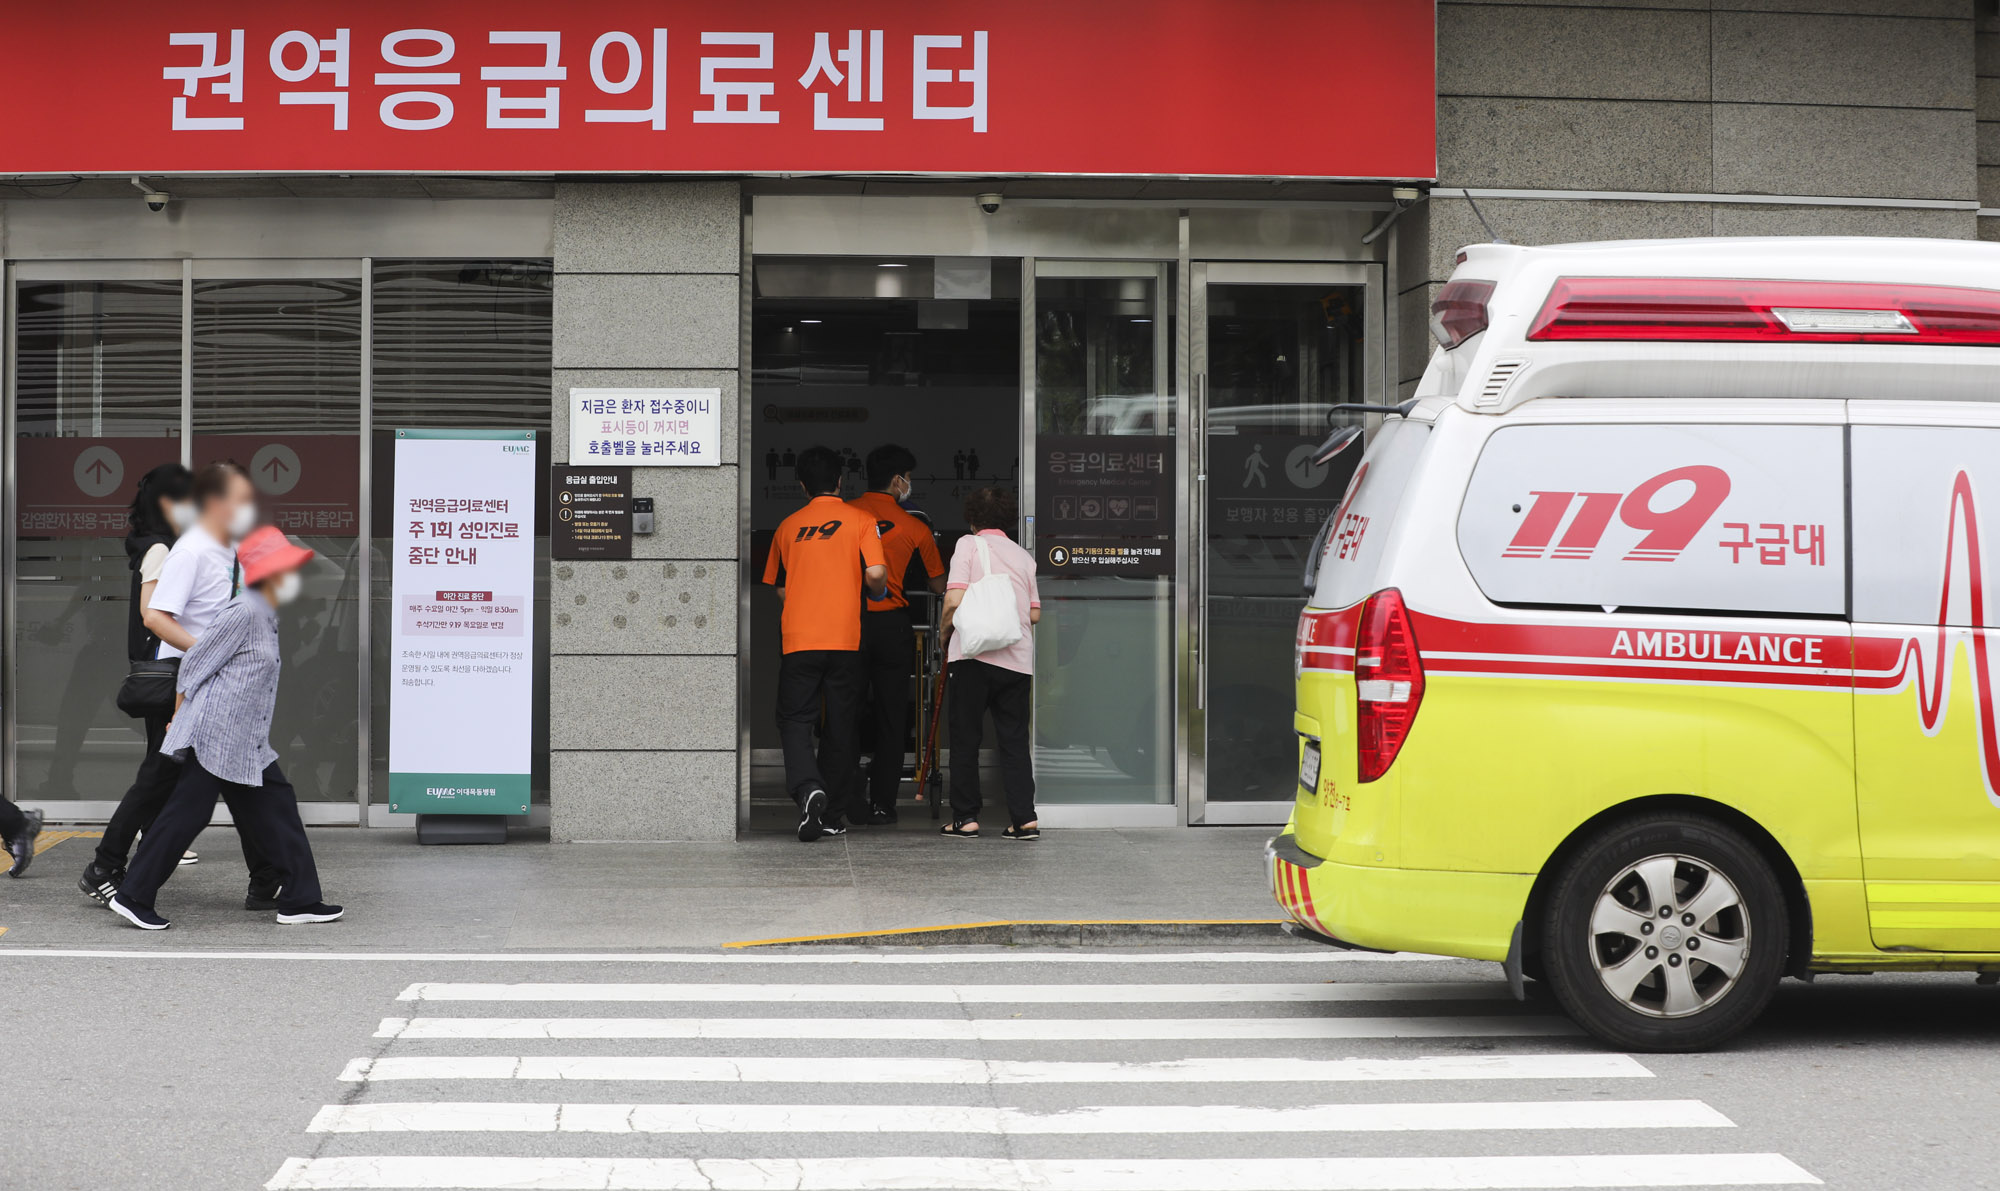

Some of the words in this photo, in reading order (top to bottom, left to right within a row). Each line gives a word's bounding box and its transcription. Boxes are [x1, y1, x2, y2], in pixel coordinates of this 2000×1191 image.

[162, 27, 989, 133] 권역응급의료센터
[581, 398, 617, 415] 지금은
[621, 398, 646, 415] 환자
[649, 398, 710, 415] 접수중이니
[600, 419, 649, 435] 표시등이
[653, 419, 690, 435] 꺼지면
[588, 440, 637, 456] 호출벨을
[640, 440, 702, 456] 눌러주세요
[1048, 451, 1164, 474] 응급의료센터
[565, 475, 587, 485] 응급실
[588, 475, 618, 485] 출입안내
[409, 498, 509, 513] 권역응급의료센터
[21, 512, 70, 530] 감염환자
[72, 512, 97, 530] 전용
[276, 511, 315, 528] 구급차
[316, 511, 354, 528] 출입구
[1226, 507, 1267, 523] 보행자
[1272, 507, 1299, 523] 전용
[1304, 507, 1330, 523] 출입
[1501, 464, 1732, 563] 119
[1719, 522, 1826, 567] 구급대
[408, 521, 425, 539] 주
[430, 521, 453, 539] 1회
[458, 521, 520, 540] 성인진료
[795, 520, 843, 543] 119
[1334, 513, 1371, 562] 구급대
[408, 546, 440, 565] 중단
[445, 546, 477, 565] 안내
[443, 592, 457, 600] 야간
[457, 592, 471, 600] 진료
[471, 592, 485, 600] 중단
[409, 604, 423, 613] 매주
[425, 604, 444, 613] 수요일
[445, 604, 459, 613] 야간
[460, 605, 474, 615] 5pm
[463, 621, 489, 629] 목요일로
[401, 650, 422, 659] 조속한
[422, 650, 436, 659] 시일
[436, 650, 450, 659] 내에
[451, 651, 509, 660] 권역응급의료센터가
[510, 652, 523, 660] 정상
[1610, 630, 1824, 665] AMBULANCE
[422, 664, 429, 673] 수
[430, 664, 450, 673] 있도록
[452, 665, 471, 673] 최선을
[456, 787, 496, 797] 이대목동병원
